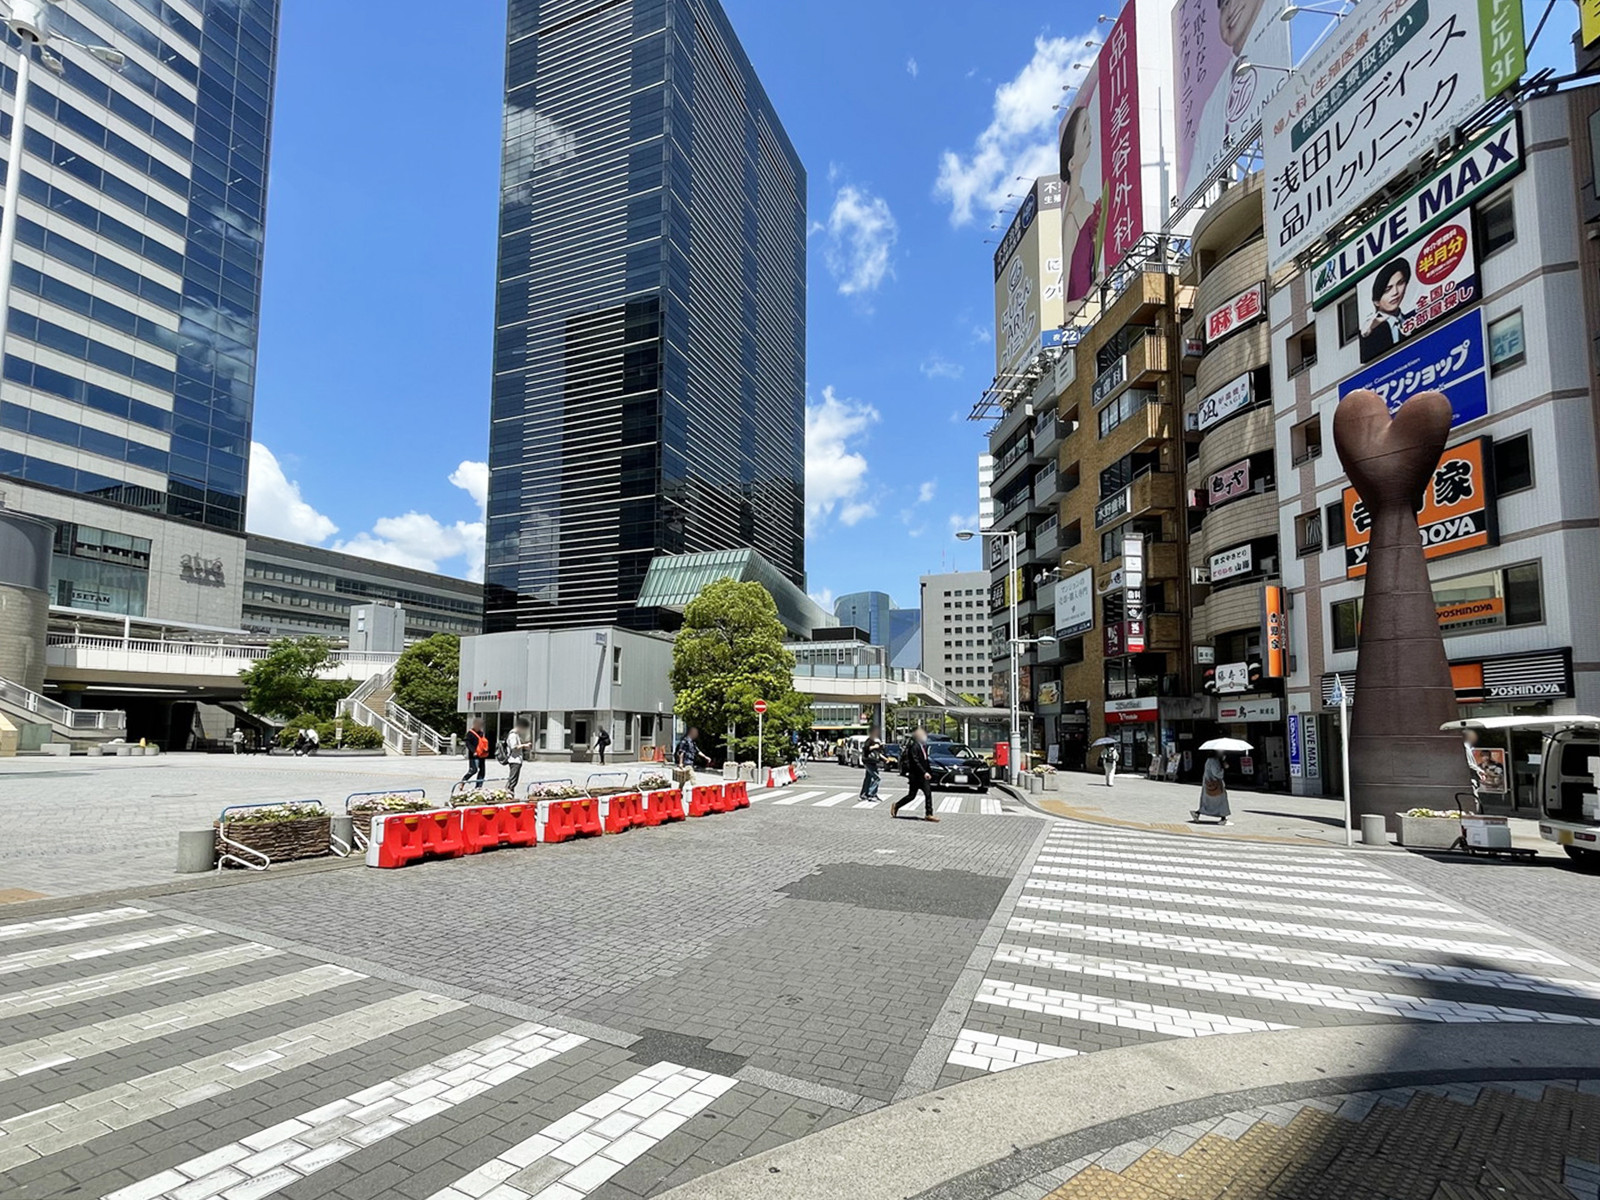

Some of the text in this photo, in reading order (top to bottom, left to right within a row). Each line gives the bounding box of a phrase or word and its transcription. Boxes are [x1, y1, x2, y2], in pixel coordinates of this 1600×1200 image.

[1302, 15, 1413, 133] 保険診療取扱い
[1491, 47, 1515, 88] 3F
[1272, 13, 1467, 211] 浅田レディース
[1109, 22, 1133, 255] 品川美容外科
[1280, 72, 1459, 247] 品川クリニック
[1418, 127, 1515, 224] MAX
[1418, 235, 1464, 273] 半月分
[1208, 290, 1261, 340] 麻雀
[1401, 286, 1474, 334] お部屋探し
[1416, 280, 1456, 309] 全国の
[1436, 603, 1493, 619] YOSHINOYA
[1490, 683, 1560, 697] YOSHINOYA
[1307, 746, 1317, 768] MAX
